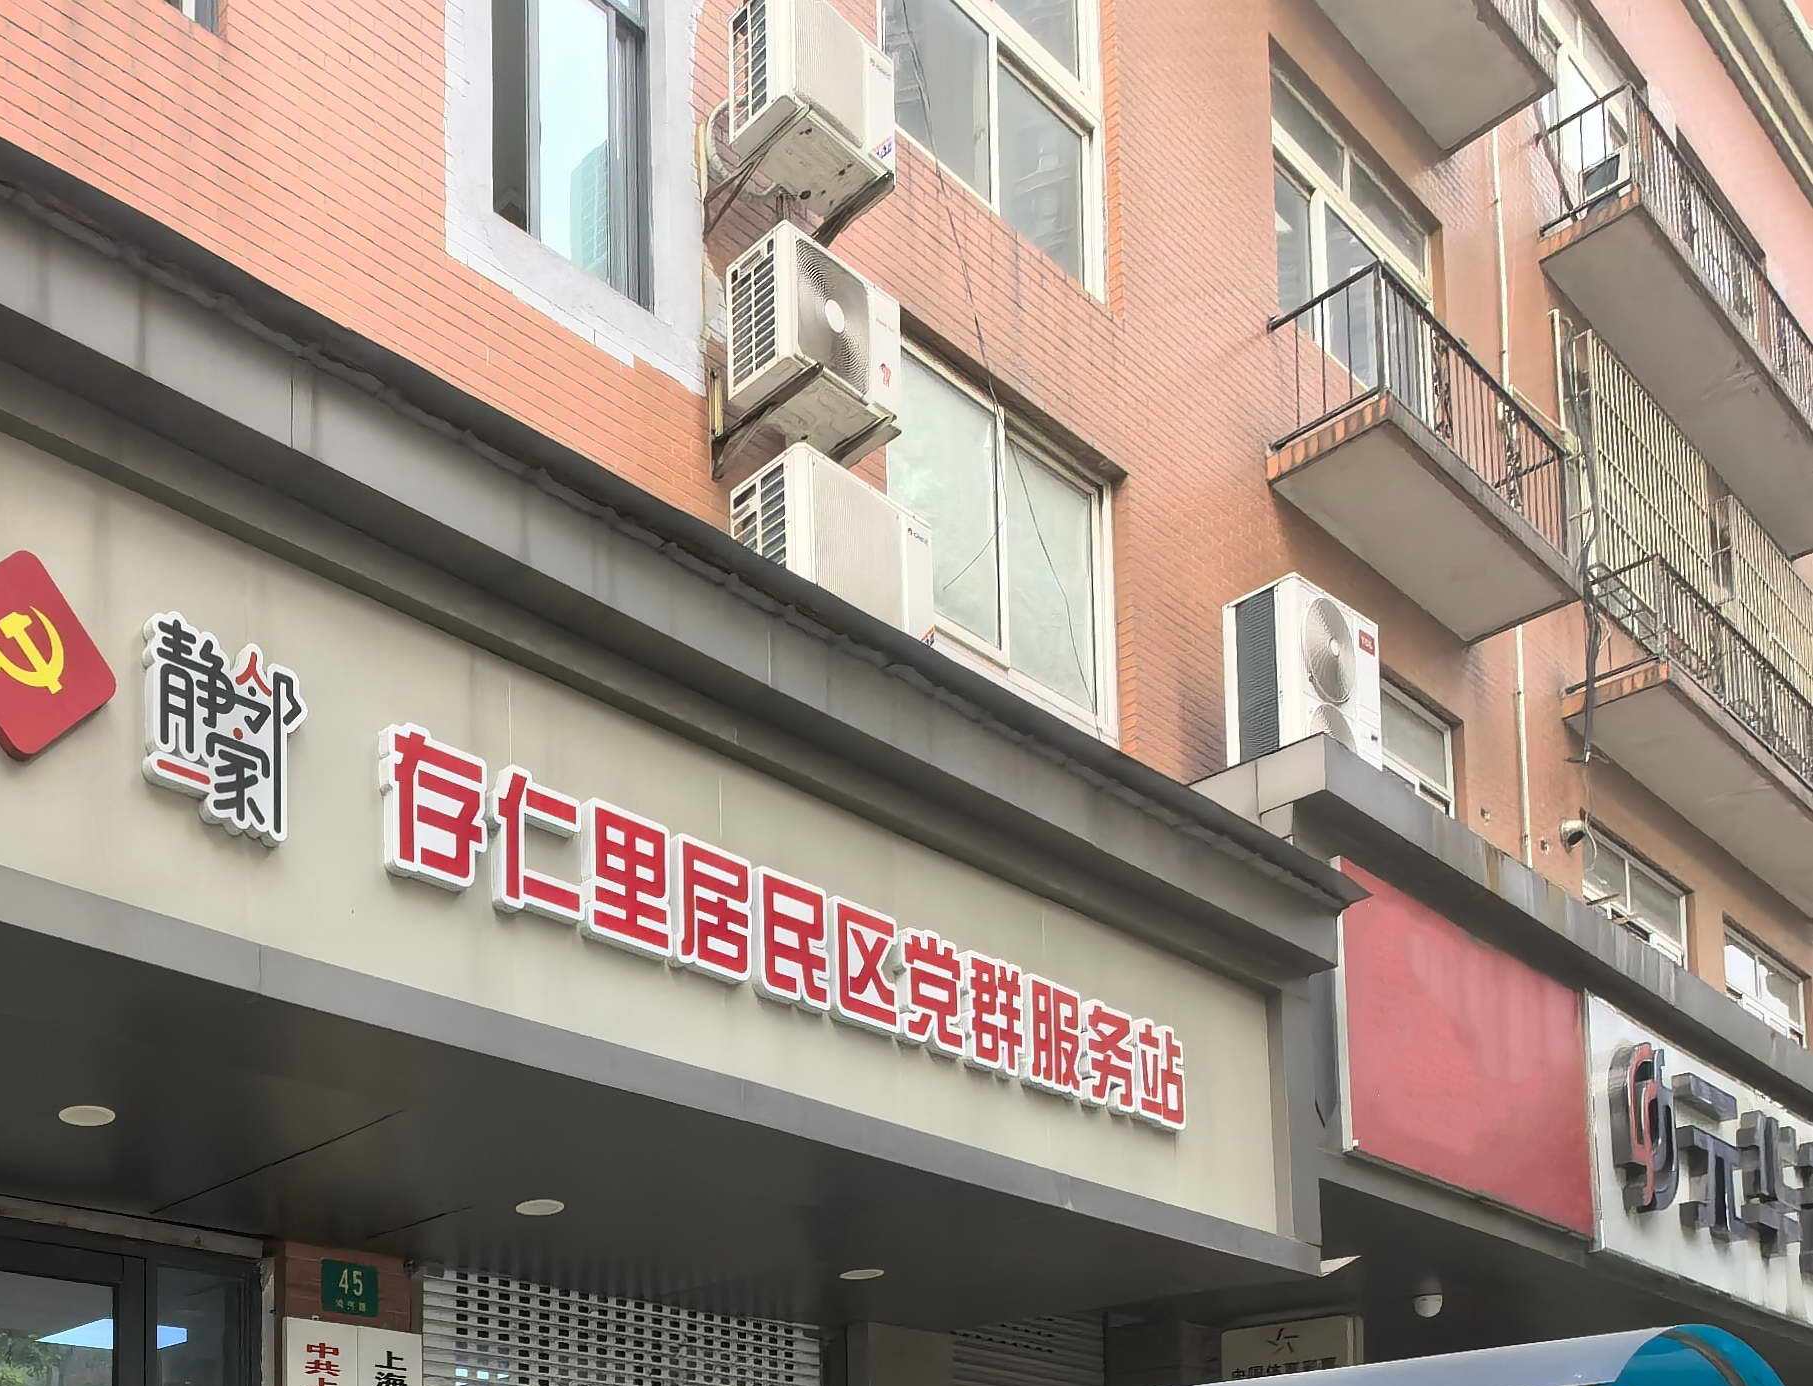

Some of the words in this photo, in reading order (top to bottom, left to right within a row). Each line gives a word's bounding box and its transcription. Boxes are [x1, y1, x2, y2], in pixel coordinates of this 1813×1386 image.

[392, 730, 1186, 1129] 存仁里居民区党群服务站
[338, 1268, 363, 1297] 45
